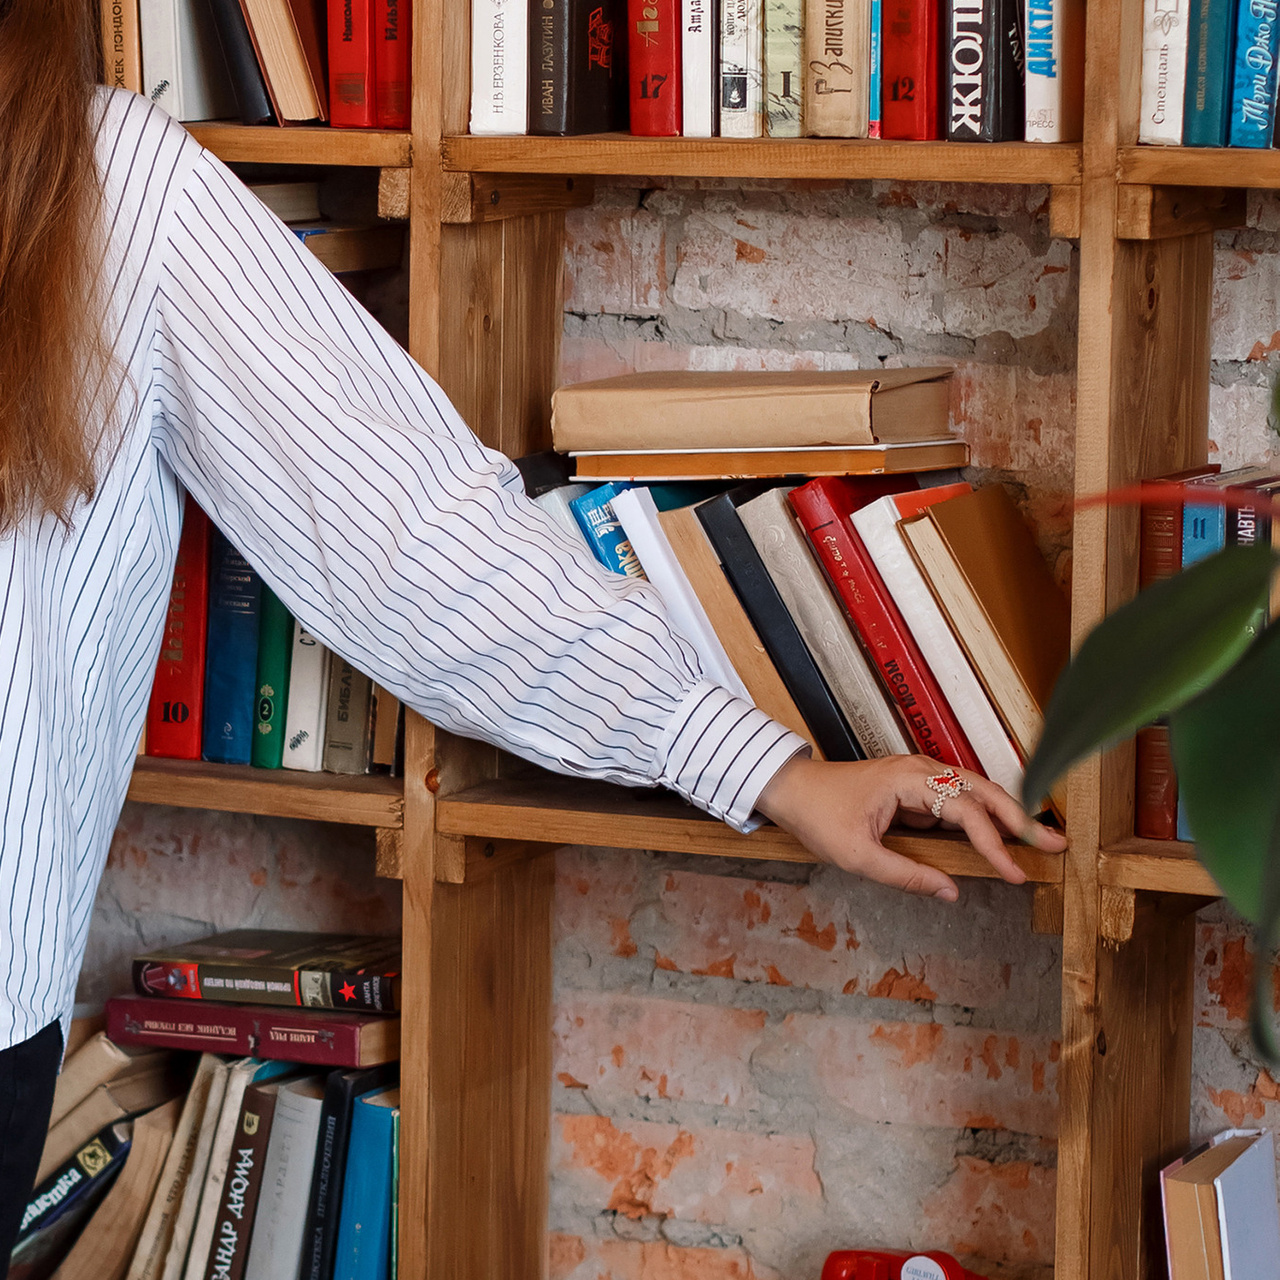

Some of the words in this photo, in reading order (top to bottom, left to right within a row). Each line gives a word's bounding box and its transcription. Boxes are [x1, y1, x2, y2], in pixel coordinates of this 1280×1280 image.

[726, 9, 735, 36] КОПИ
[541, 15, 554, 72] ЛАЗУТИН
[541, 78, 554, 115] ИВАН
[638, 73, 669, 100] 17
[890, 77, 915, 102] 12
[1151, 43, 1169, 125] Стендаль
[161, 701, 190, 724] 10
[261, 703, 270, 716] 2
[362, 980, 370, 1005] КАНТА
[144, 1019, 176, 1032] ГОЛОВЫ
[177, 1022, 195, 1034] БЕЗ
[197, 1024, 237, 1037] ВСАДНИК
[270, 1030, 288, 1042] РИД
[290, 1032, 316, 1044] МАЙН
[319, 1115, 337, 1218] ПРИКЛЮЧЕНИЙ
[227, 1147, 255, 1219] ДЮМА
